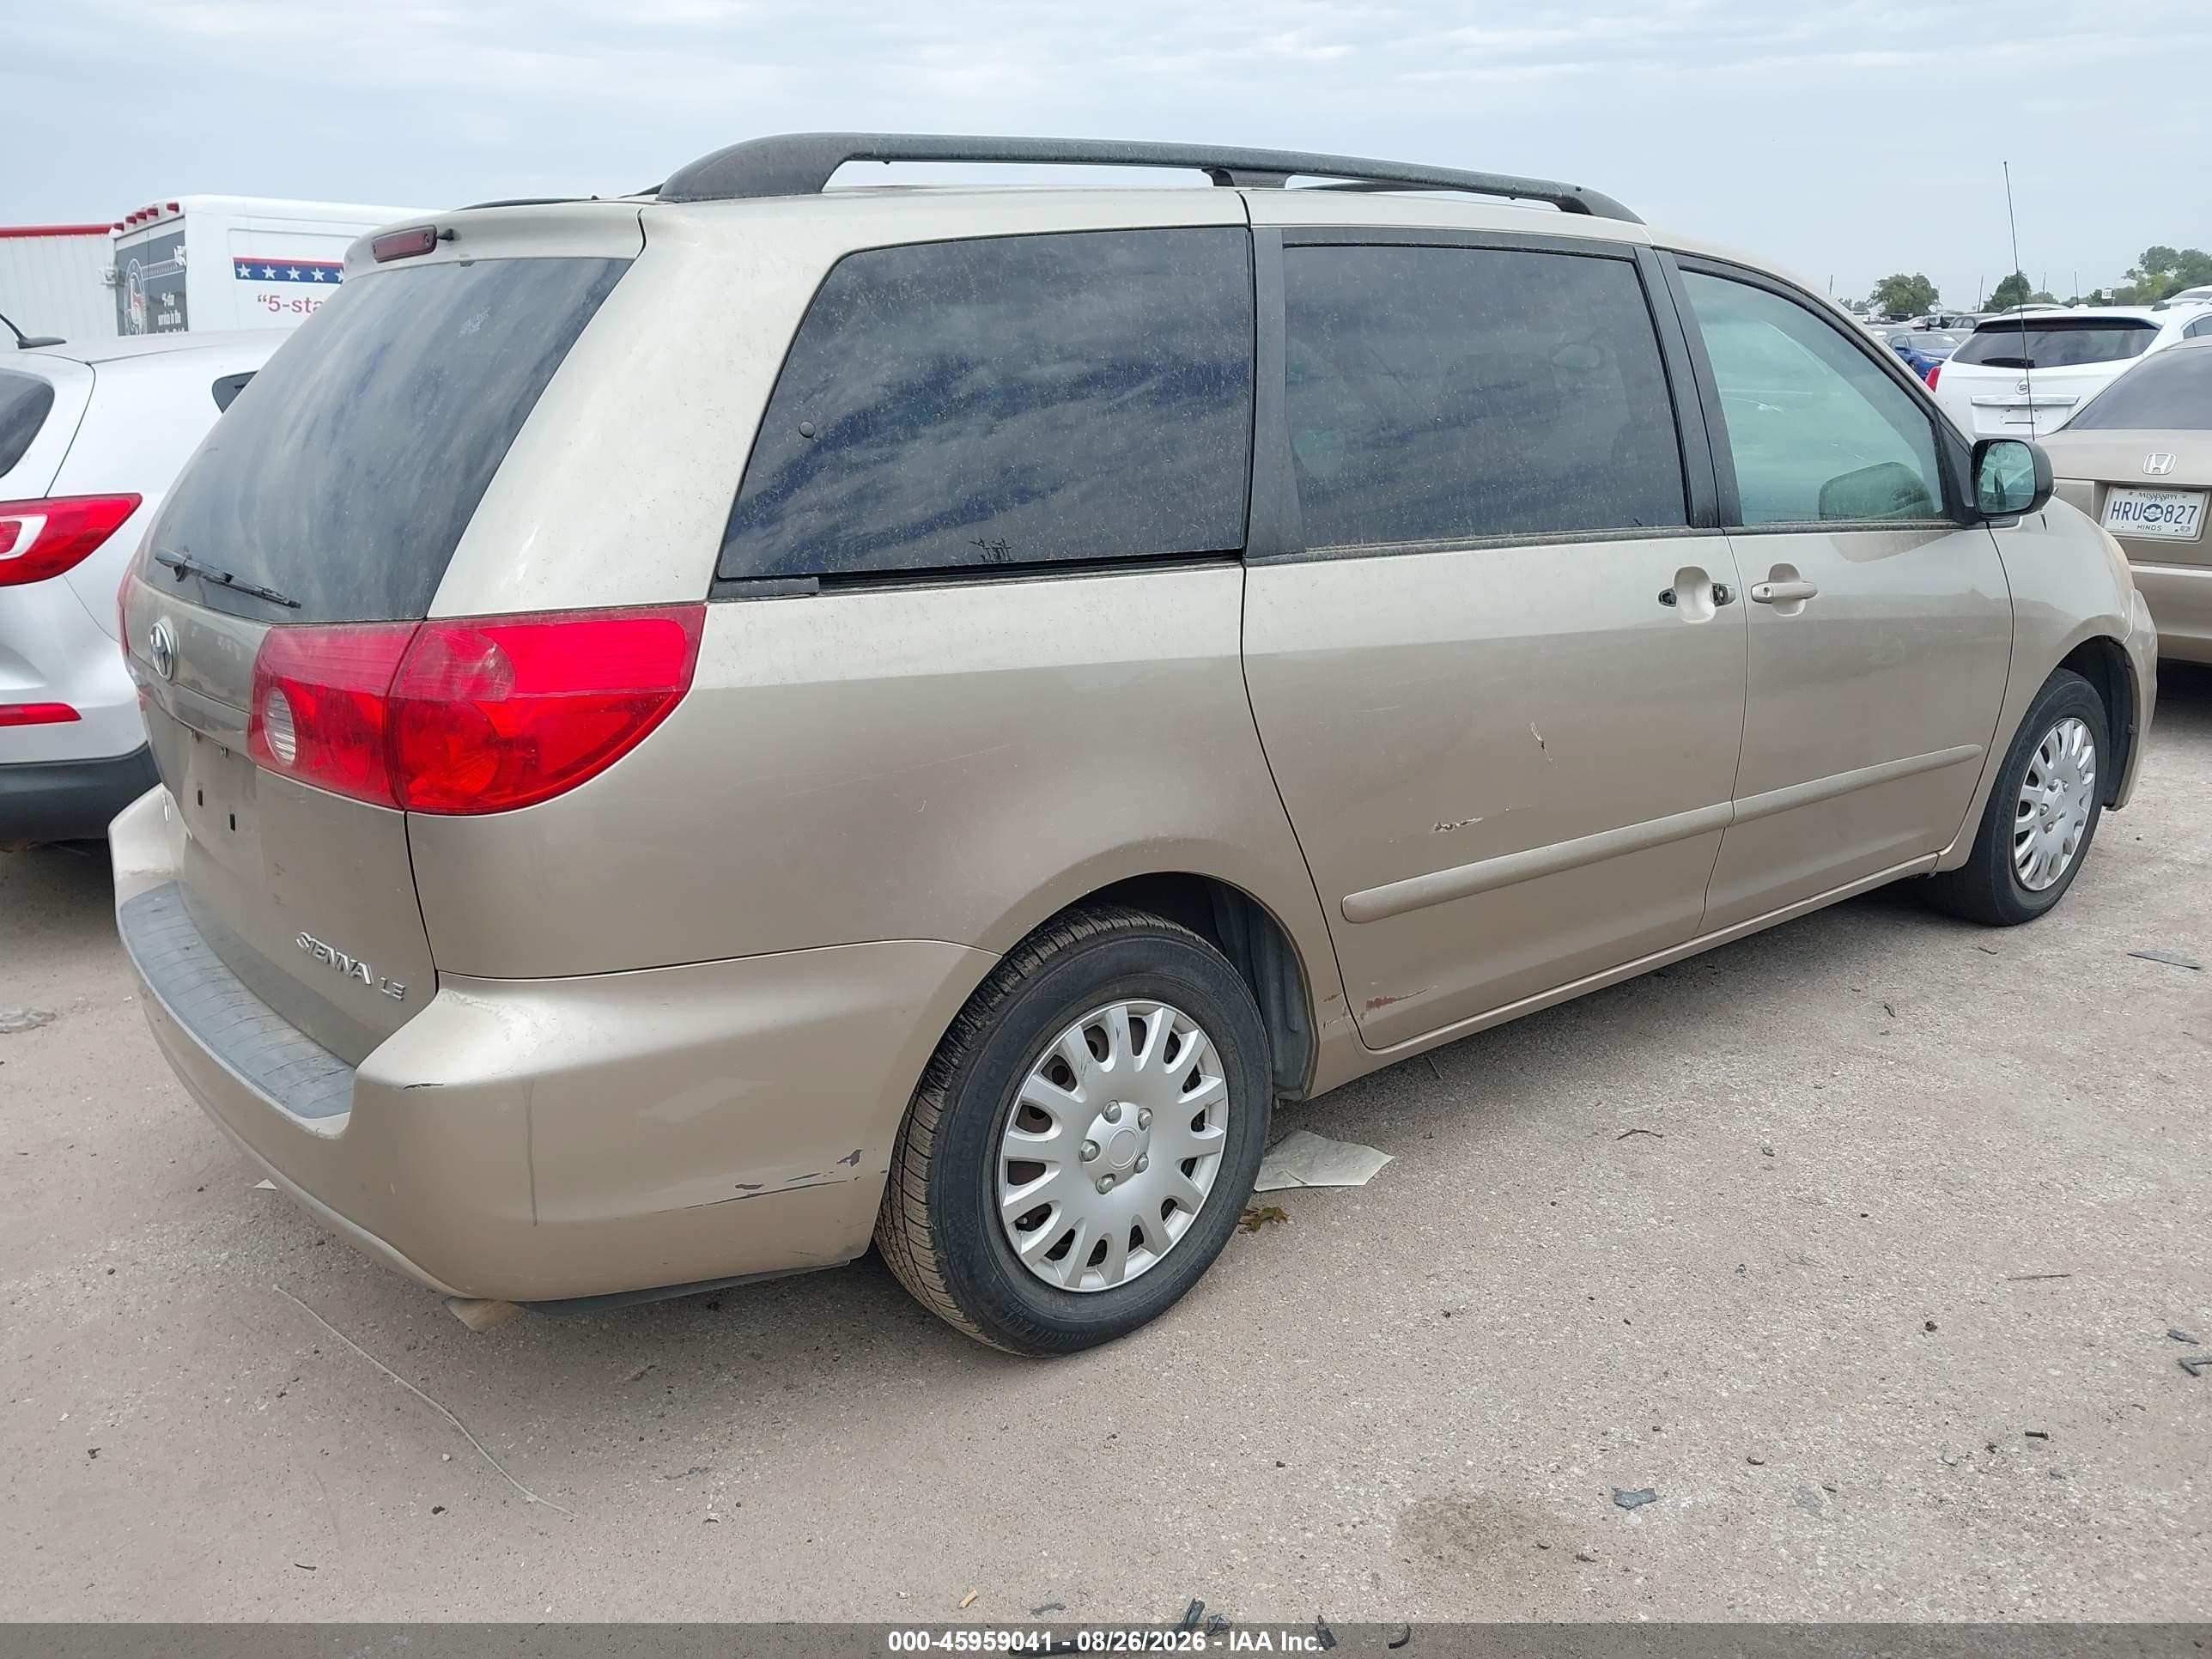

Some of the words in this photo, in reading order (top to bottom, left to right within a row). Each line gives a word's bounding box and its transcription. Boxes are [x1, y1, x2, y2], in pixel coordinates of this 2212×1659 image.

[2111, 501, 2144, 521] HRU
[2164, 505, 2197, 525] 827
[295, 932, 374, 985] SIENNA
[380, 976, 406, 1002] LE
